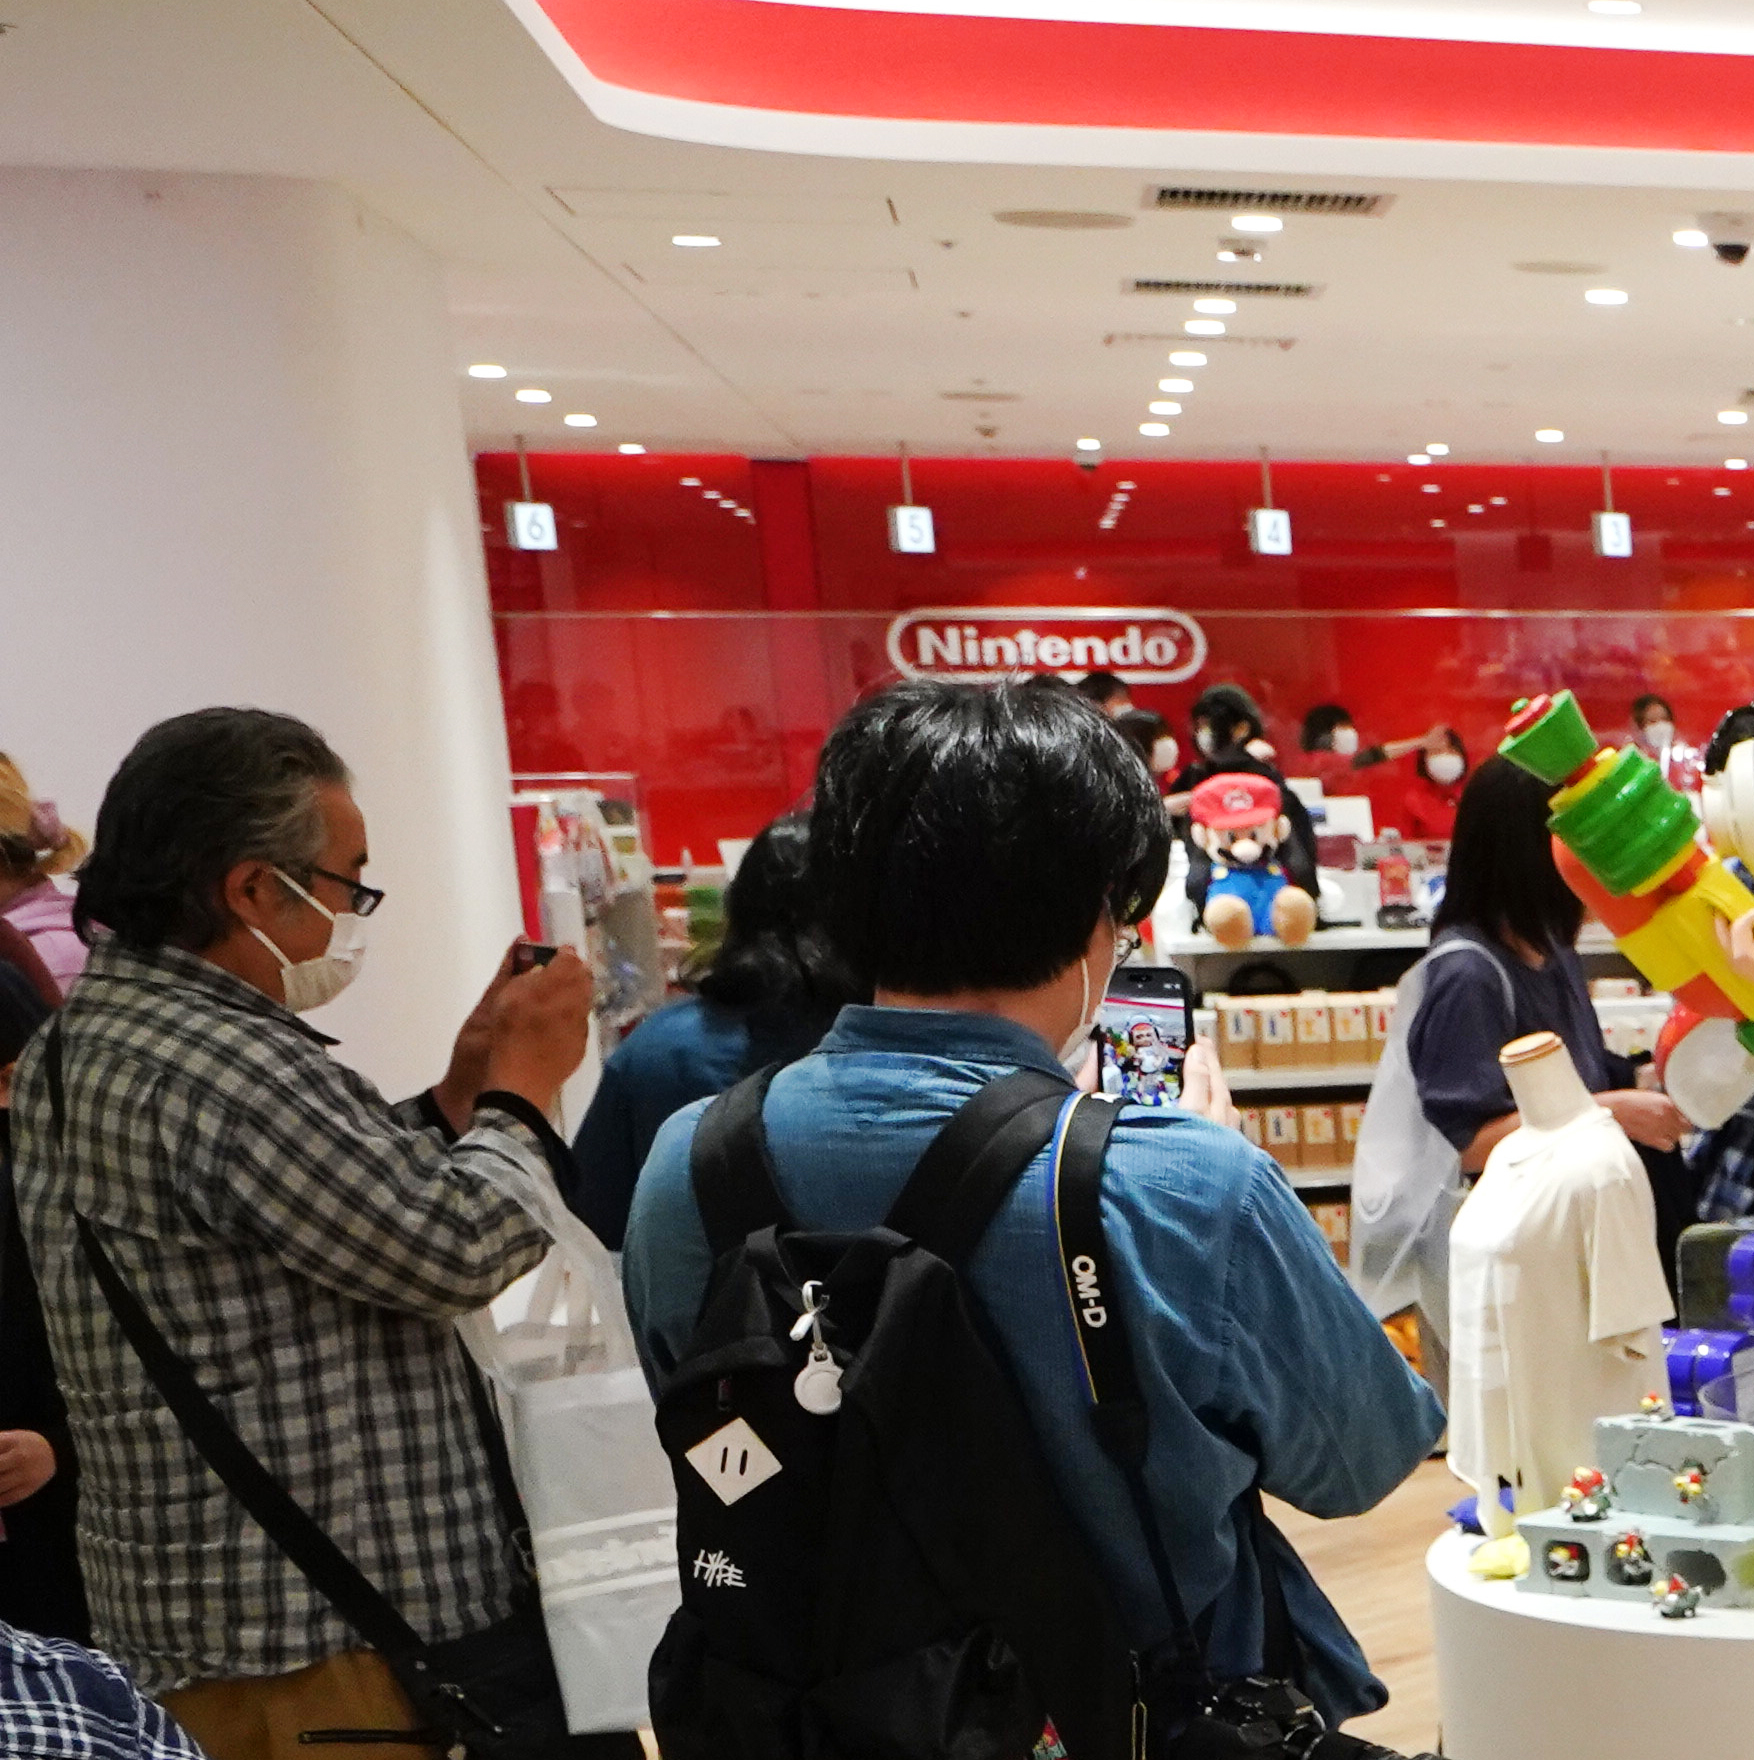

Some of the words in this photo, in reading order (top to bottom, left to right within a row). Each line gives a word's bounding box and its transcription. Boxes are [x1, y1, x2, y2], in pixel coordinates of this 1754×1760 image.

[526, 510, 546, 541] 6
[908, 511, 925, 545] 5
[1267, 519, 1281, 544] 4
[916, 626, 1177, 666] Nintendo
[1072, 1255, 1107, 1329] OM-D
[693, 1548, 747, 1588] HYPE
